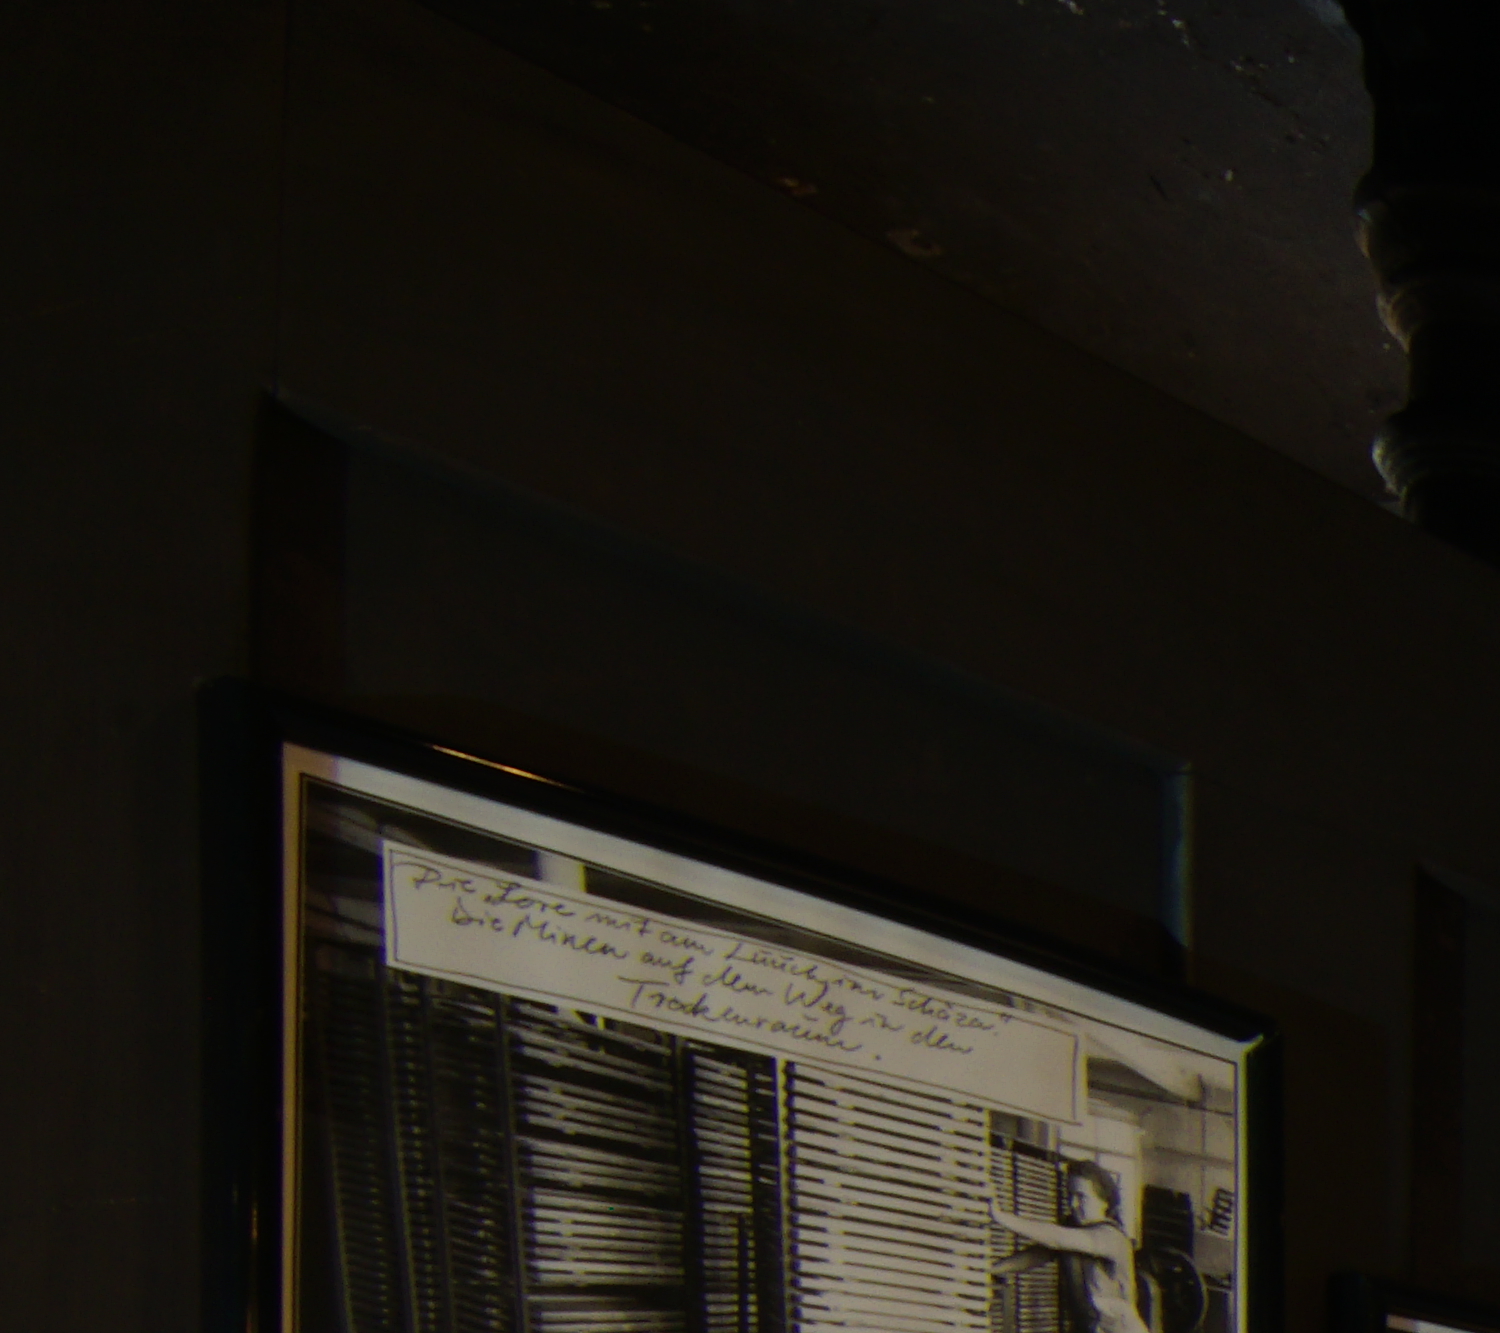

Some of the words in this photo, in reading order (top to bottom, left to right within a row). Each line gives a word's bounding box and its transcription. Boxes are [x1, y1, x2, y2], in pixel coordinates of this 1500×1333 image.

[513, 915, 629, 959] Minen
[640, 951, 696, 984] auf
[702, 965, 773, 995] dem
[785, 981, 851, 1031] Weg
[585, 911, 652, 936] mit
[660, 930, 714, 956] am
